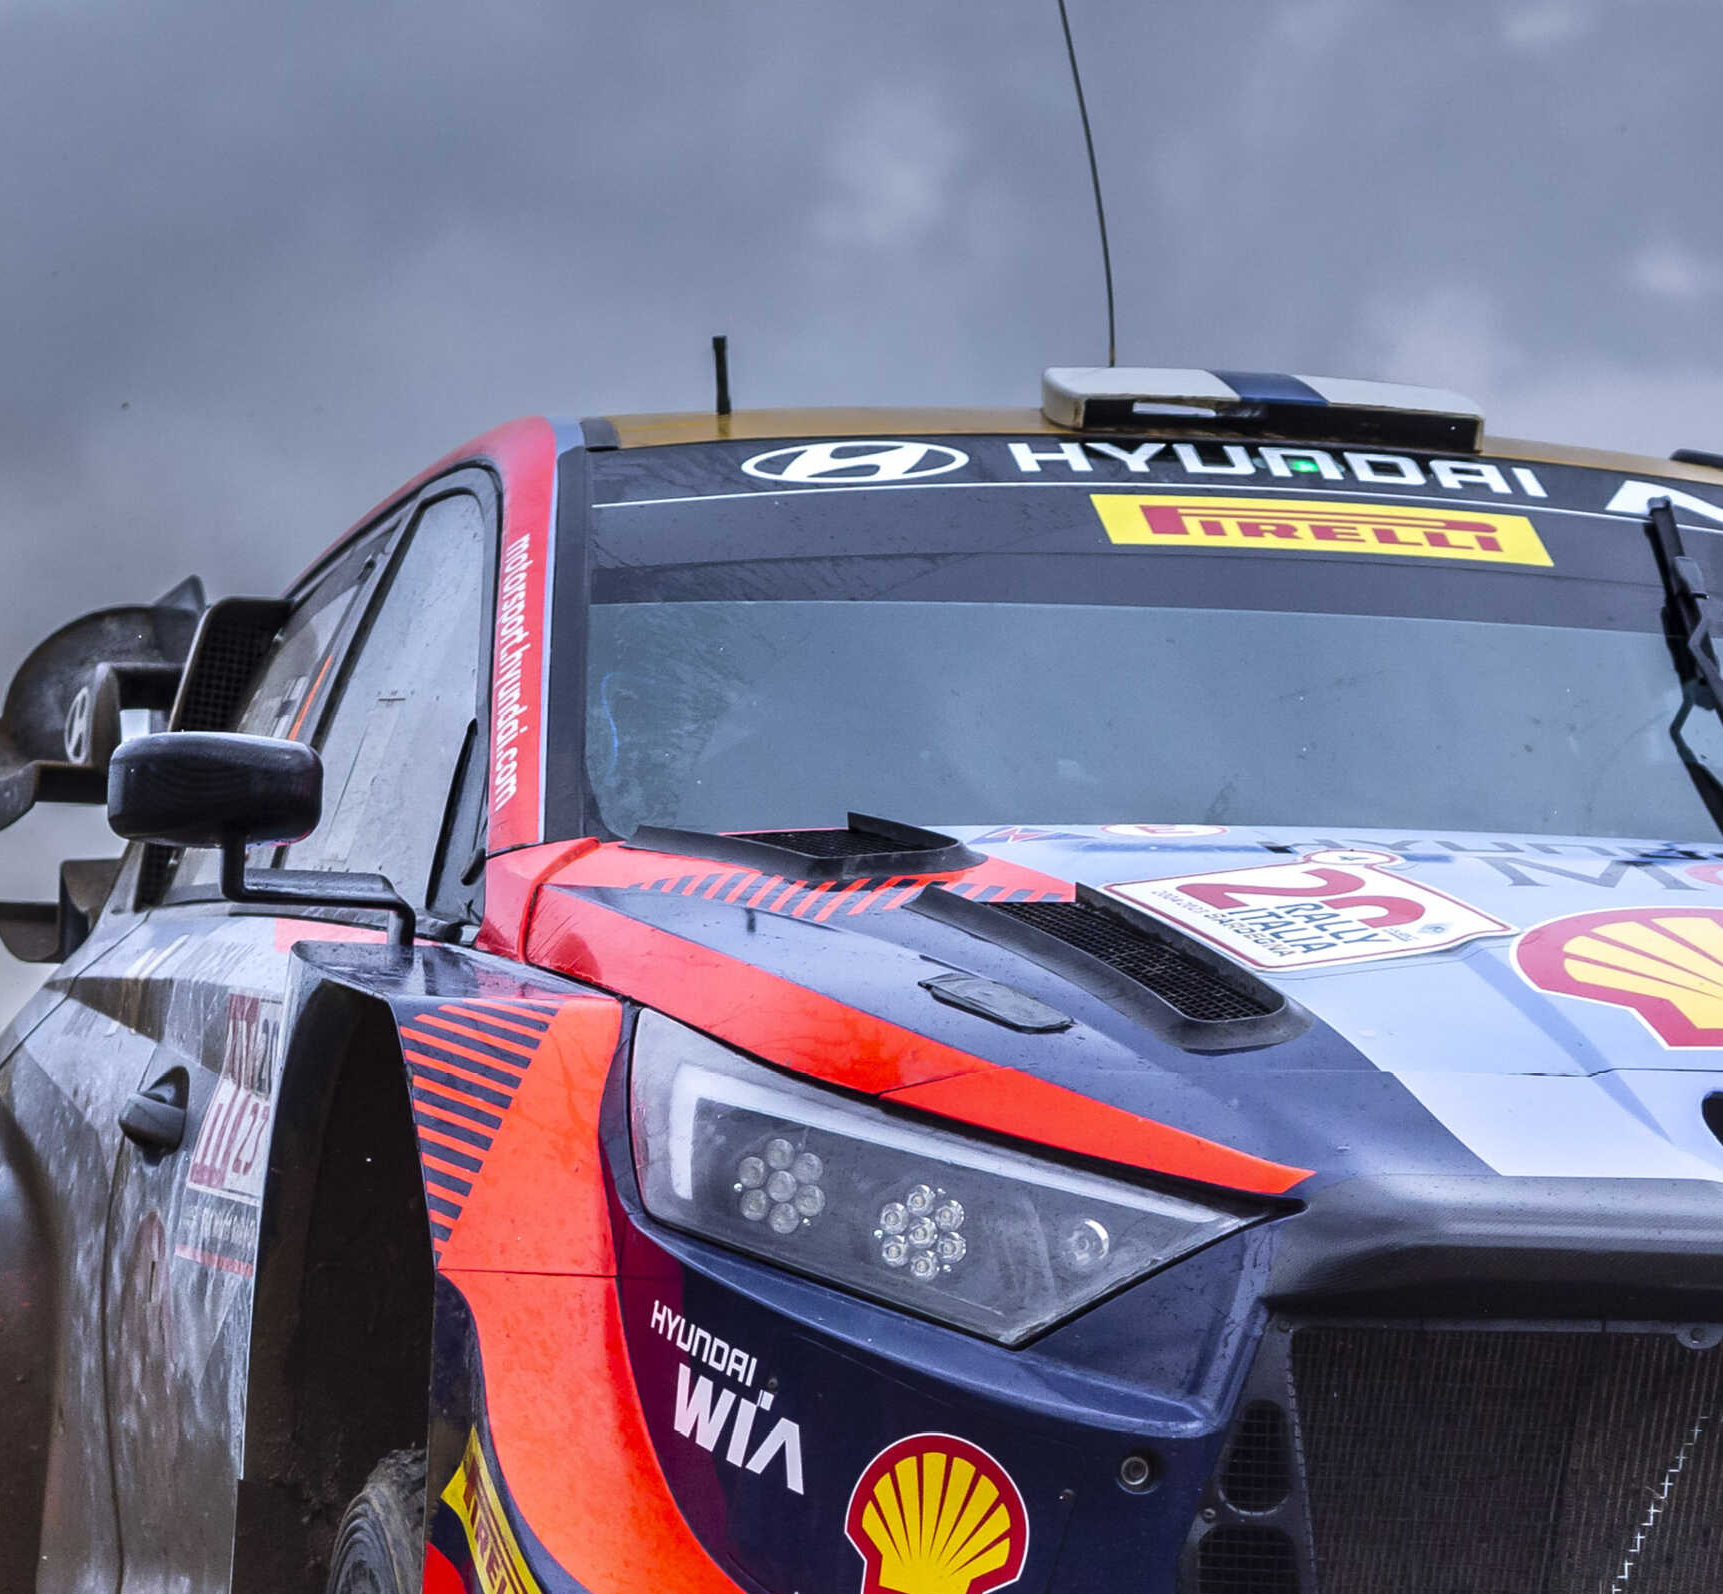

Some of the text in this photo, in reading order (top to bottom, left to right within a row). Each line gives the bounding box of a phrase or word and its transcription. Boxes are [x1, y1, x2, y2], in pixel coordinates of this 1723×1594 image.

[1008, 441, 1549, 497] HYUNDAI
[1140, 503, 1504, 552] PIRELLI
[494, 533, 533, 812] motorsport.hyundai.com
[1204, 913, 1298, 958] SARDEGNA
[1227, 907, 1337, 954] ITALIA
[1274, 902, 1391, 944] RALLY
[650, 1299, 758, 1387] HYUNDAI
